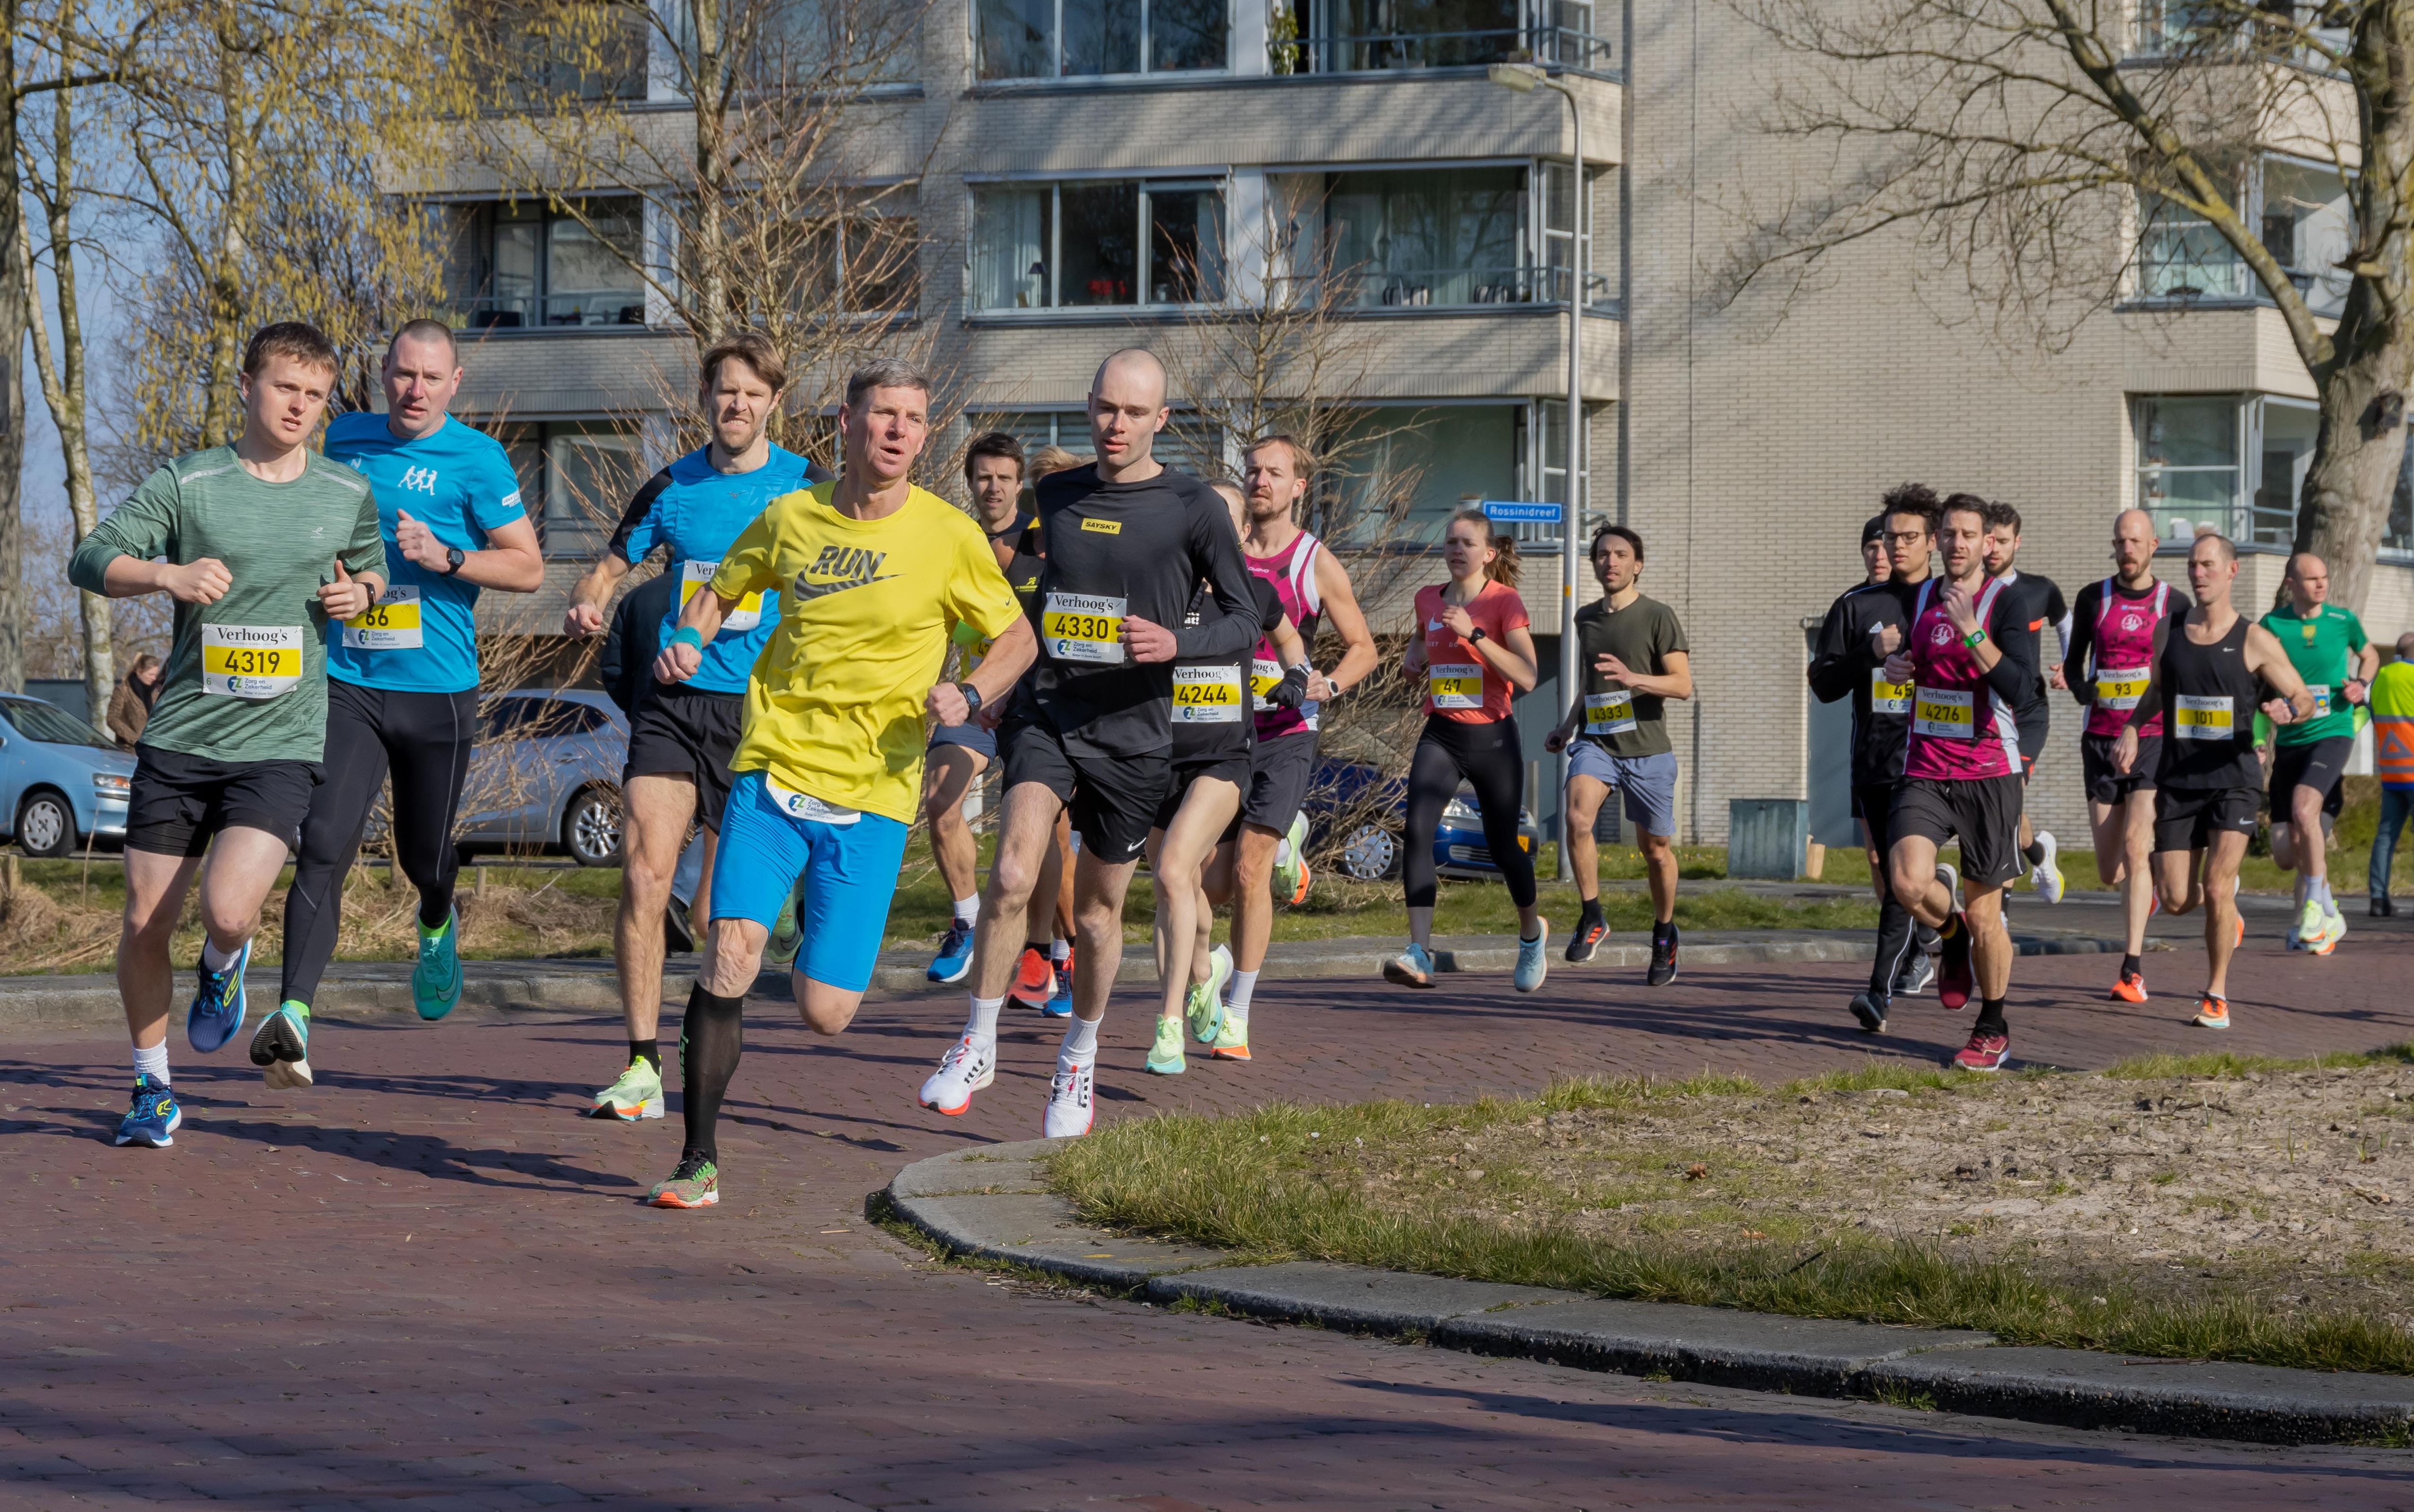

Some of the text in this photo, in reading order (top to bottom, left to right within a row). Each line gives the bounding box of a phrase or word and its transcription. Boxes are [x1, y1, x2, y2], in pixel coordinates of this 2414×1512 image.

[1490, 506, 1556, 517] Rossinidreef
[1085, 521, 1117, 530] SAYSKY
[810, 545, 887, 580] RUN
[1055, 595, 1113, 613] Verhoog's
[1055, 615, 1109, 639] 4330
[217, 627, 288, 645] Verhoog's
[225, 650, 280, 674] 4319
[1175, 668, 1229, 680] Verhoog's
[1436, 665, 1474, 676] Verhoog's
[1444, 679, 1461, 692] 47
[1894, 684, 1913, 697] 45
[2115, 683, 2131, 695] 93
[1178, 685, 1227, 703] 4244
[1923, 688, 1963, 703] Verhoog's
[1594, 705, 1623, 720] 4333
[1925, 704, 1960, 721] 4276
[2194, 711, 2213, 724] 101
[808, 799, 821, 808] Zorg
